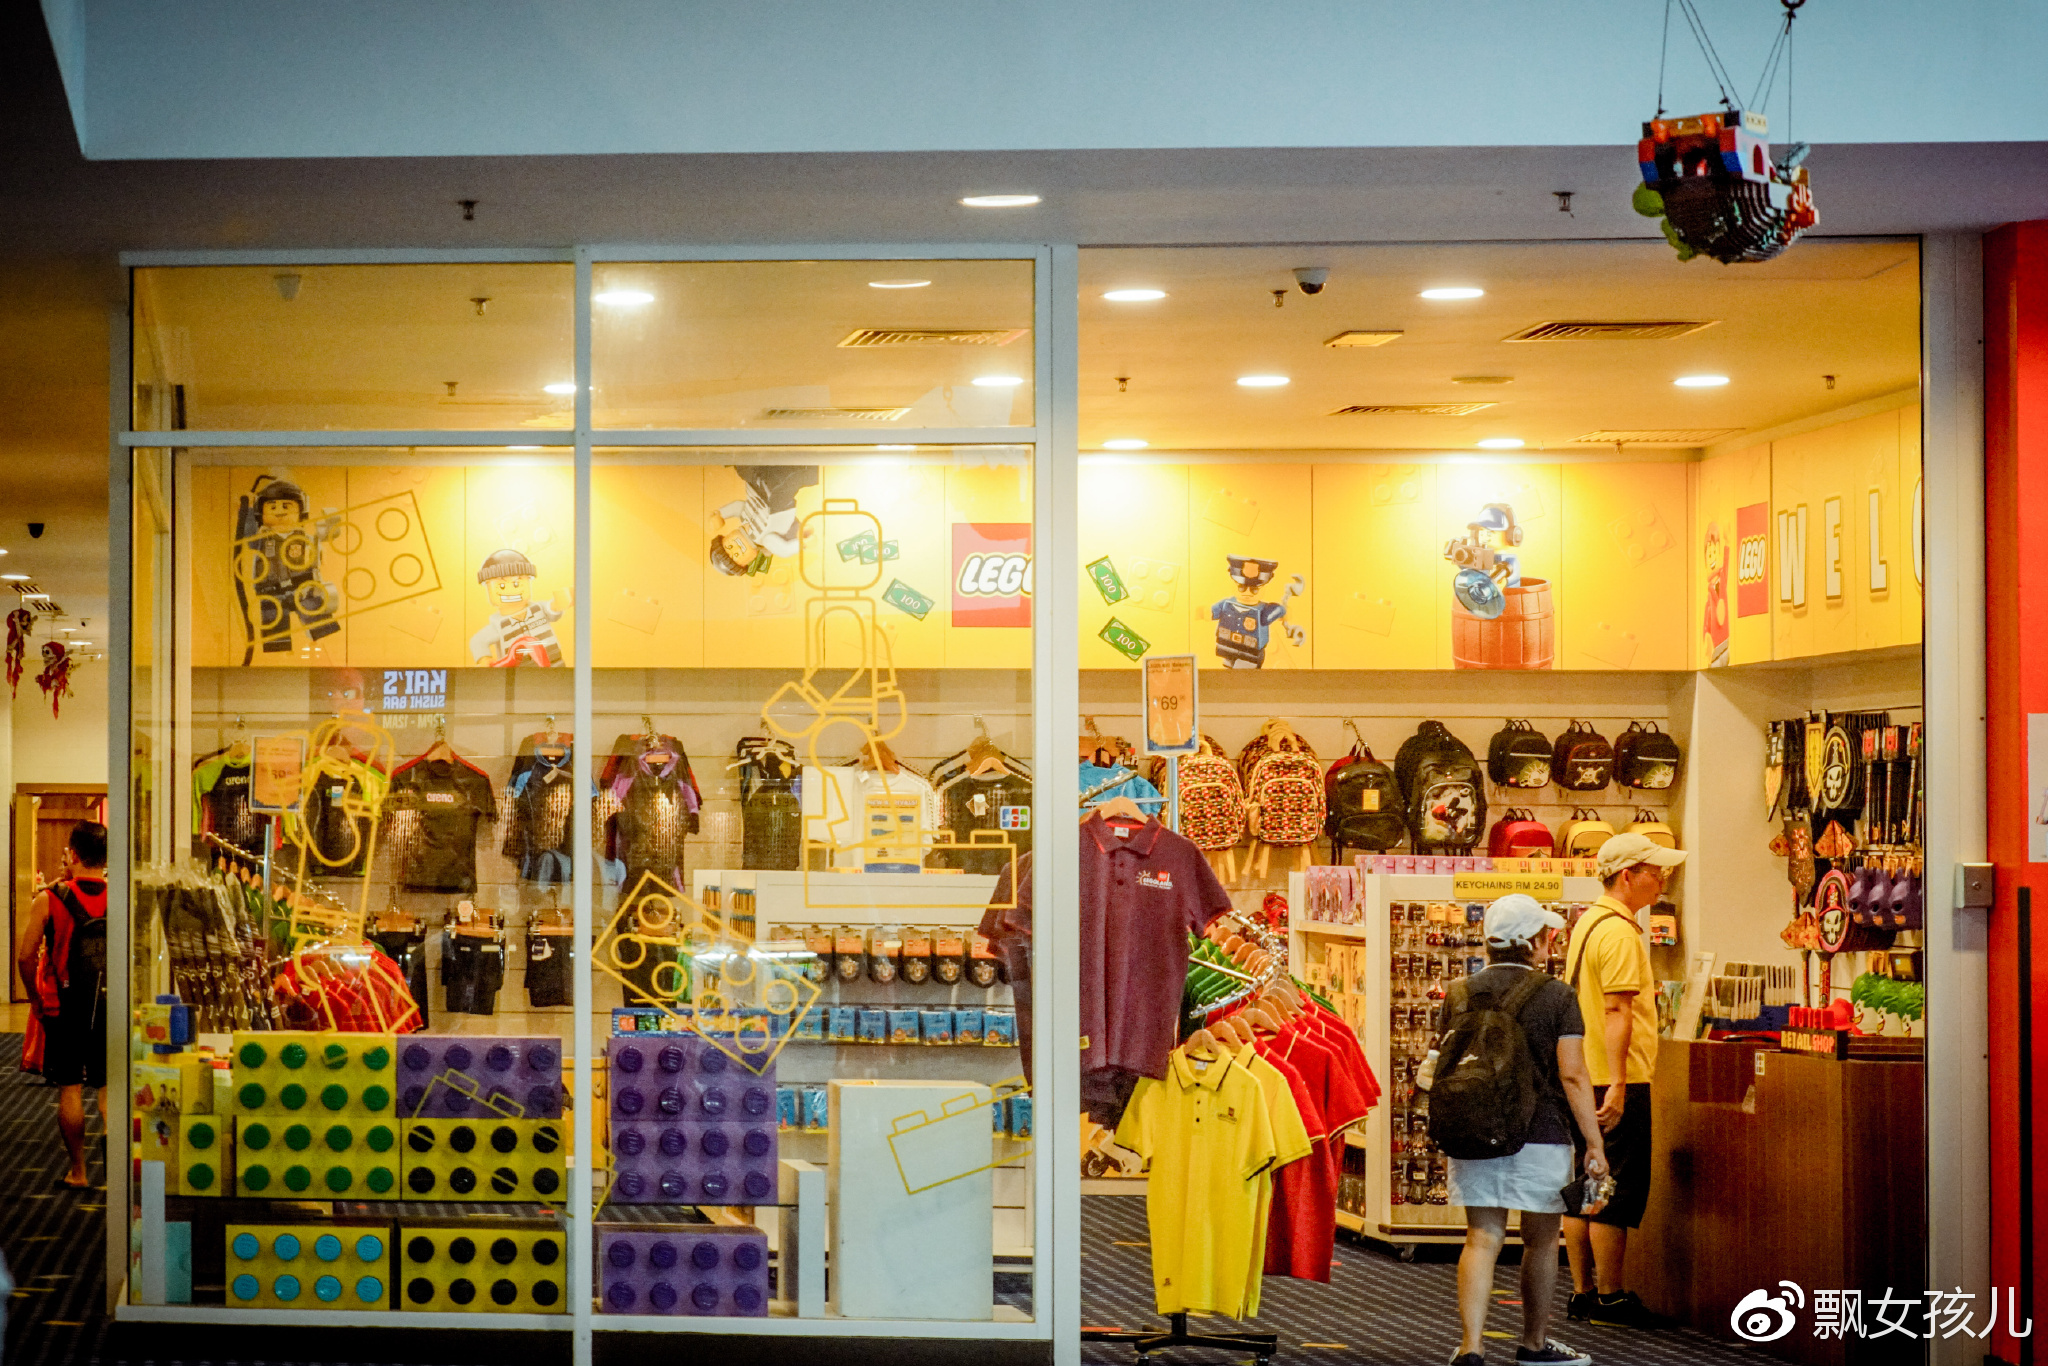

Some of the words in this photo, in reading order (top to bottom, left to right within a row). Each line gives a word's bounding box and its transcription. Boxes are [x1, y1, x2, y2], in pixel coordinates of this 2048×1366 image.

[1738, 534, 1767, 583] LEGO
[1099, 573, 1116, 594] 100
[900, 594, 921, 610] 100
[1115, 633, 1136, 650] 100
[1161, 696, 1178, 711] 69
[426, 792, 454, 803] arena
[1455, 881, 1513, 889] KEYCHAINS
[1516, 882, 1531, 890] RM
[1534, 882, 1559, 890] 24.90
[1781, 1031, 1812, 1051] RETAIL
[1811, 1034, 1836, 1054] SHOP
